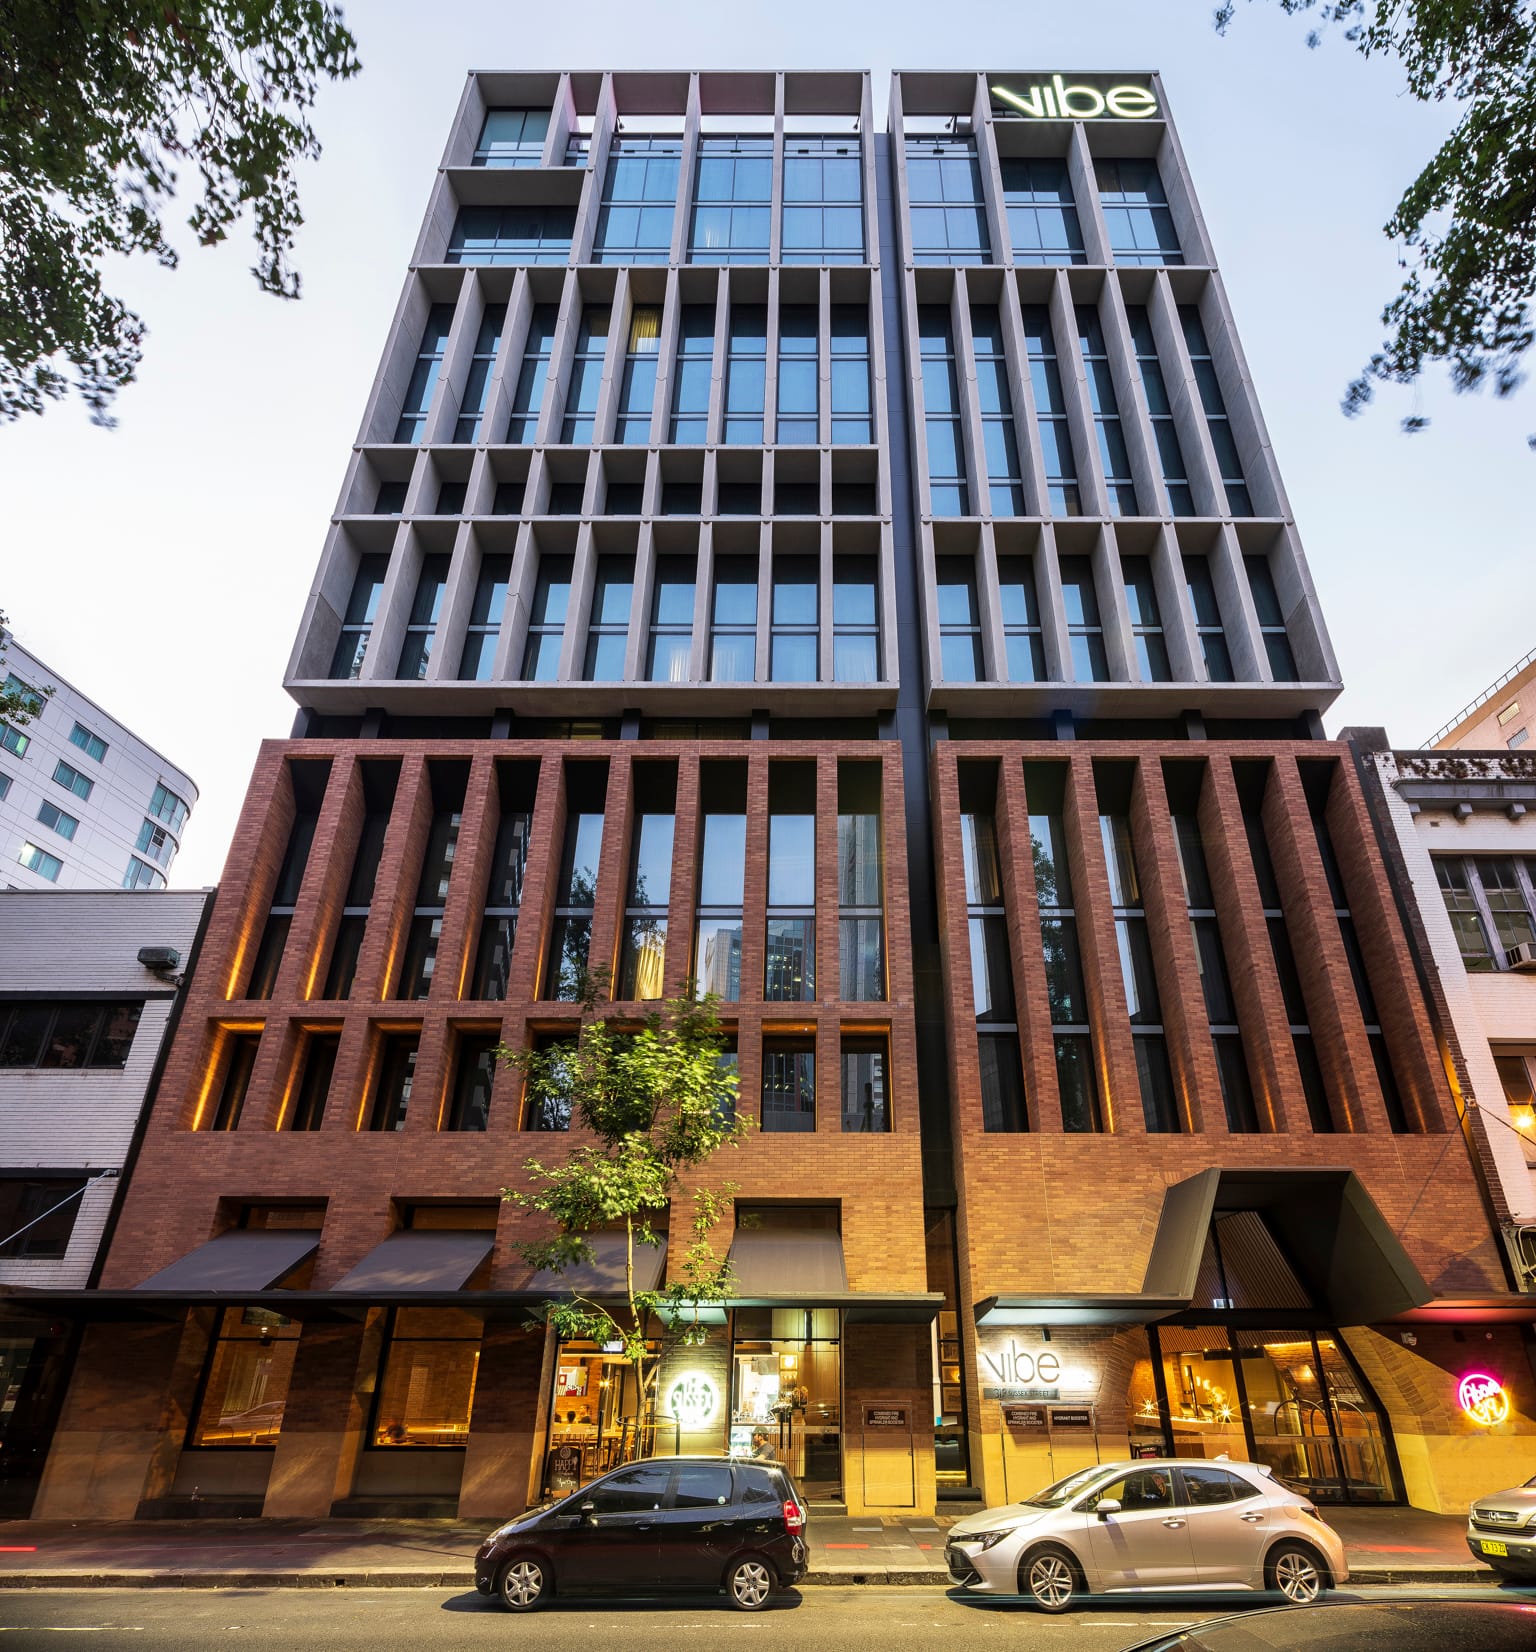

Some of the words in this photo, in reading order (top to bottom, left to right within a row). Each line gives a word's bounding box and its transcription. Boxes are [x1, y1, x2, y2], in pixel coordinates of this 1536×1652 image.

[991, 75, 1158, 118] vibe
[982, 1340, 1060, 1384] vibe
[1008, 1390, 1028, 1398] SUSSEX
[1029, 1390, 1049, 1398] STREET
